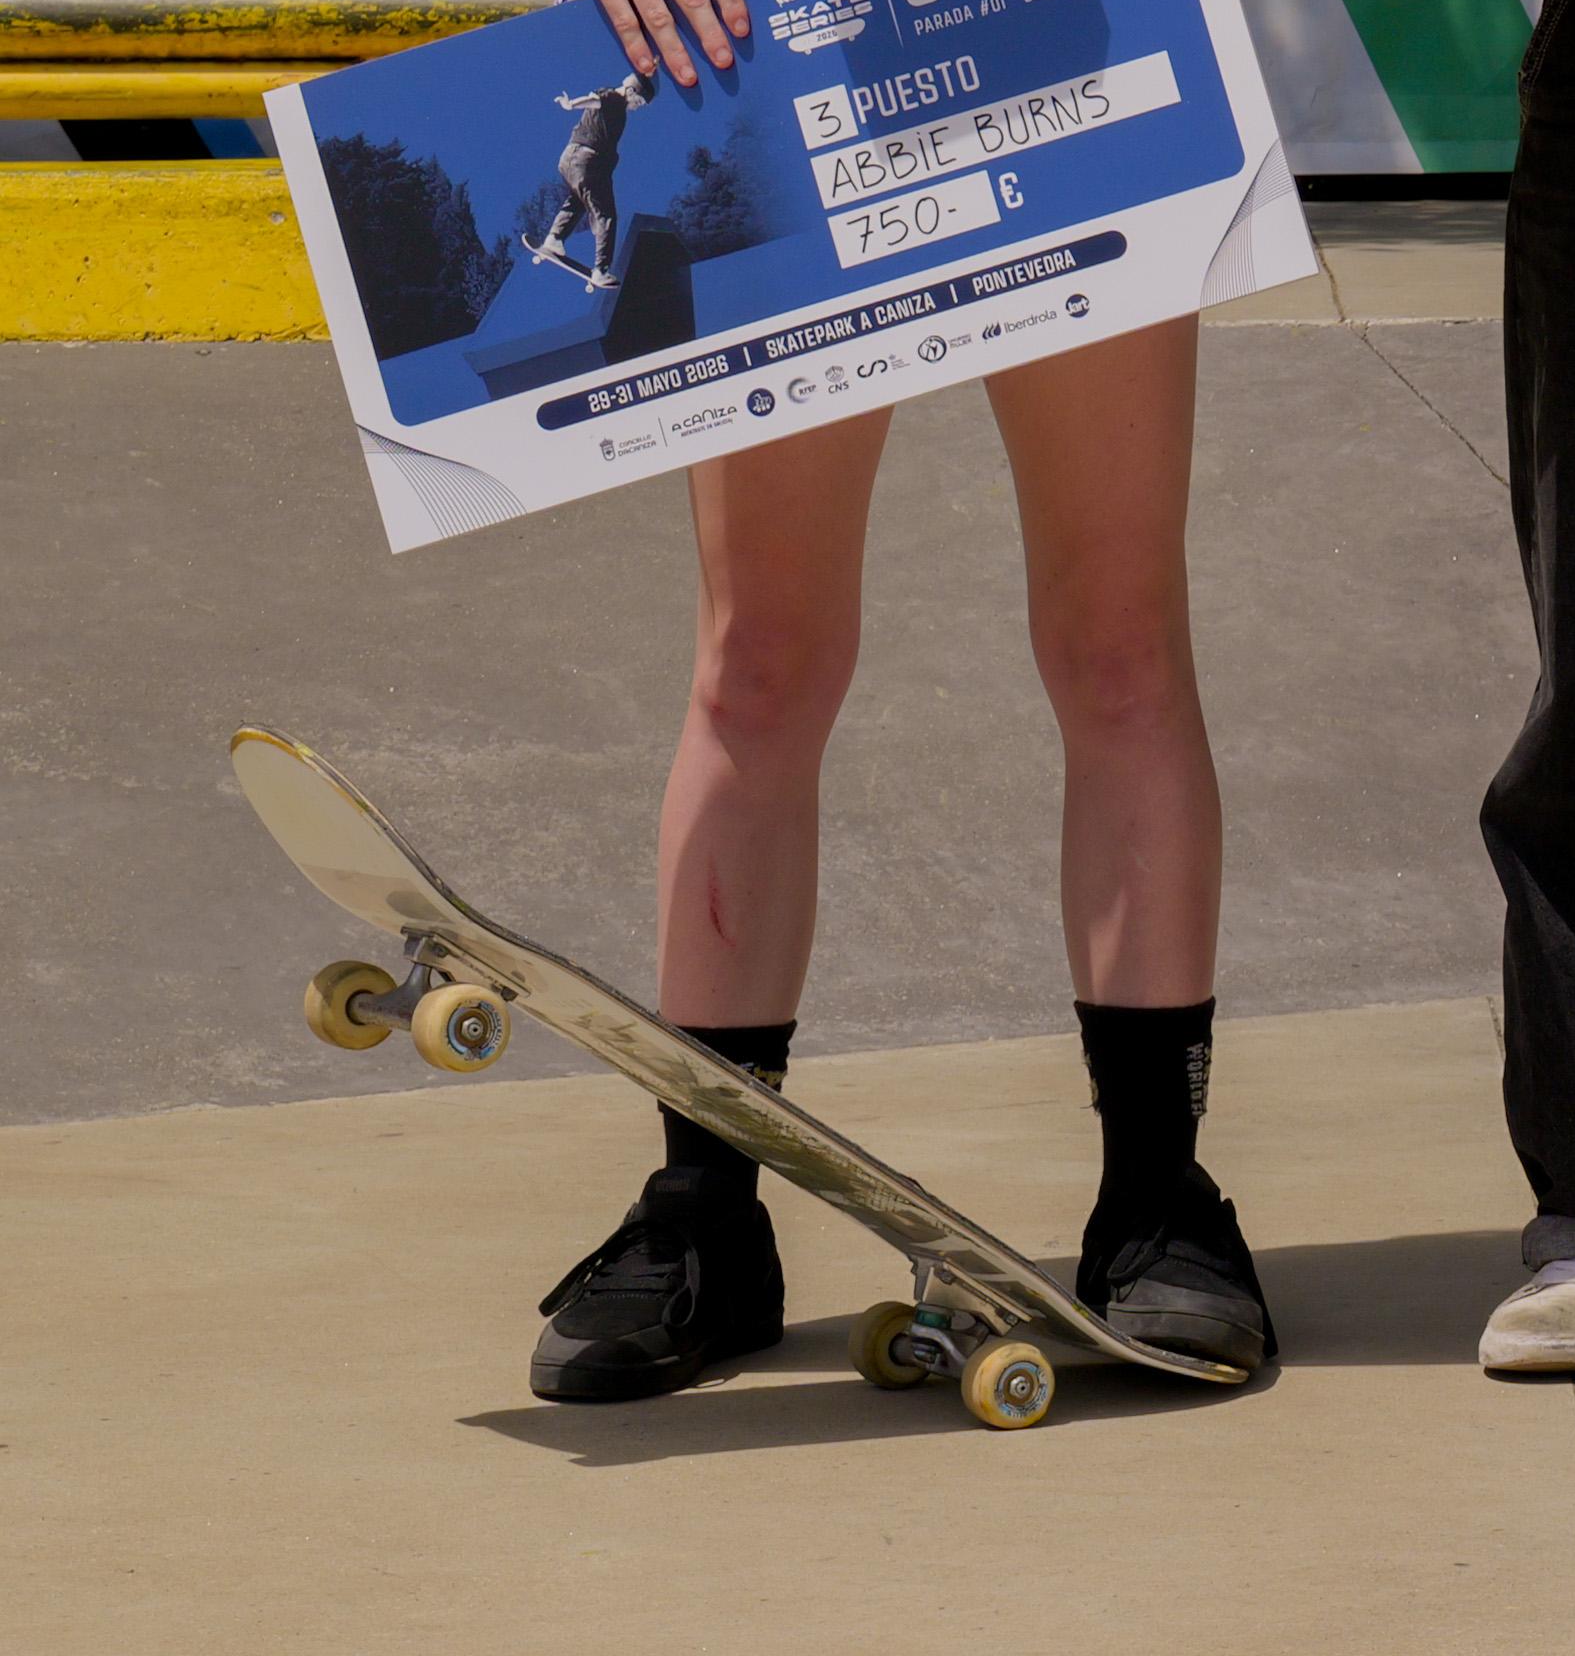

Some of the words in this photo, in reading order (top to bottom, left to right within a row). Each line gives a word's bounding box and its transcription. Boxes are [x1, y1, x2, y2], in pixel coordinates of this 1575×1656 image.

[772, 0, 873, 41] SERIES
[914, 5, 973, 36] PARADA
[852, 55, 981, 124] PUESTO
[810, 101, 842, 138] 3
[974, 80, 1111, 153] BURNS
[588, 386, 634, 414] 29-31
[637, 370, 682, 399] MAYO
[685, 354, 730, 385] 2026
[765, 315, 856, 360] SKATEPARK
[860, 311, 873, 332] A
[875, 291, 937, 326] CANIZA
[973, 247, 1077, 297] PONTEVEDRA
[1004, 310, 1058, 334] Iberdrola
[828, 381, 850, 395] CNS
